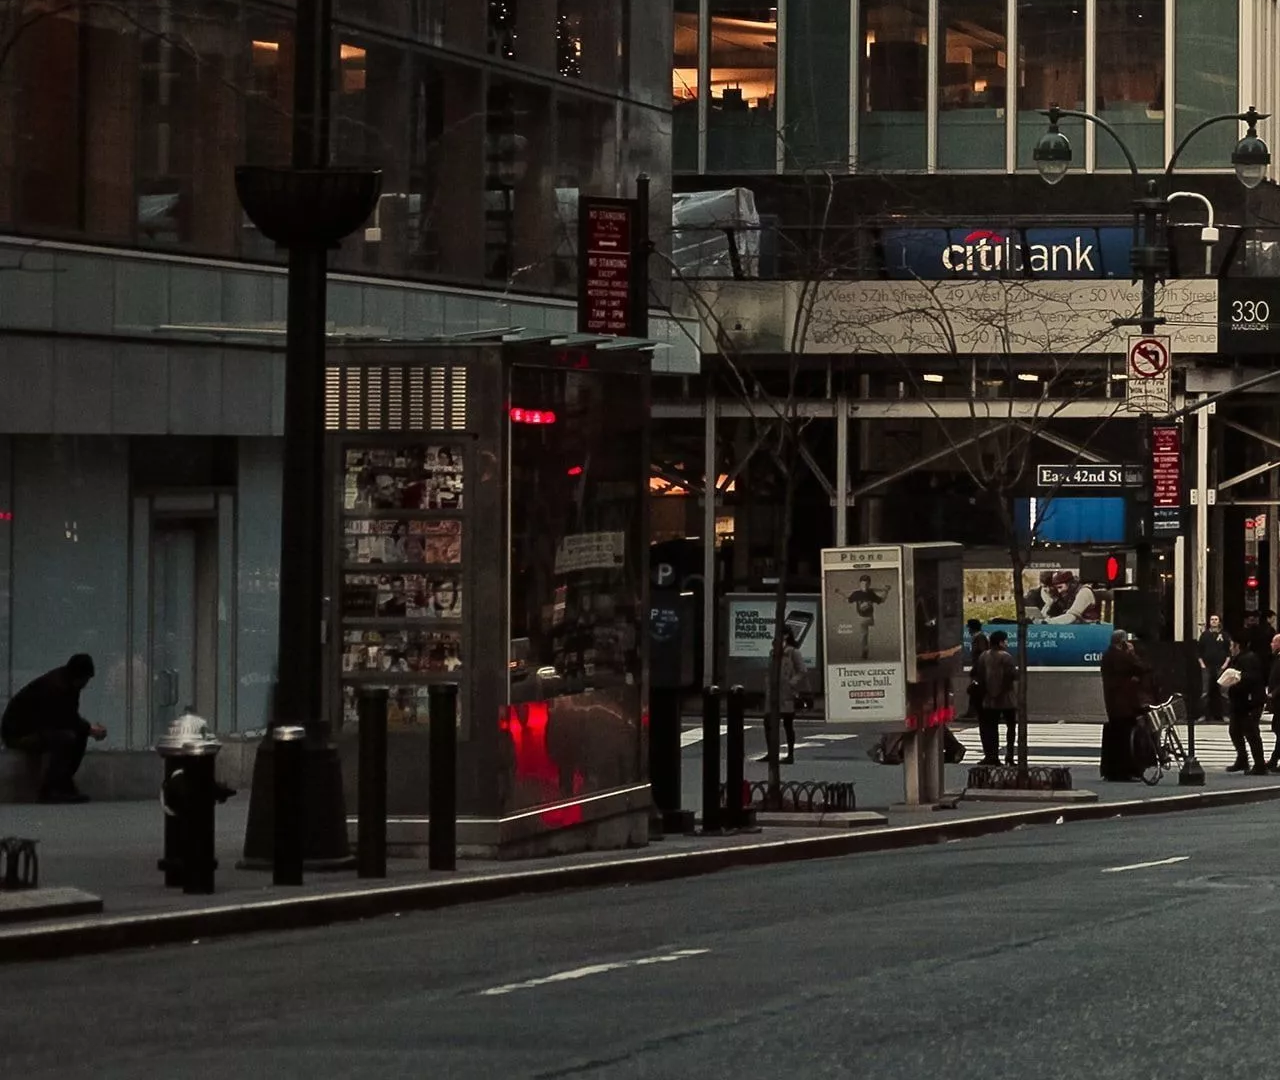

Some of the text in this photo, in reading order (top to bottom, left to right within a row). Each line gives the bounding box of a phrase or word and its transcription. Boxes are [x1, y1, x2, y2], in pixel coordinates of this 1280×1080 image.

[942, 236, 1095, 271] citibank
[945, 288, 965, 302] 49
[1090, 288, 1107, 302] 50
[1109, 288, 1140, 302] Wes
[1182, 288, 1217, 302] Street
[1231, 301, 1270, 322] 330
[1231, 322, 1269, 331] MADISON
[1173, 331, 1217, 344] Avenue
[1073, 470, 1105, 482] 42nd
[1108, 470, 1122, 482] St
[840, 553, 884, 562] Phone
[658, 563, 673, 585] P
[735, 631, 773, 639] RINGING.
[836, 668, 897, 677] Threw cancer
[849, 679, 872, 687] curve
[873, 677, 892, 687] ball.
